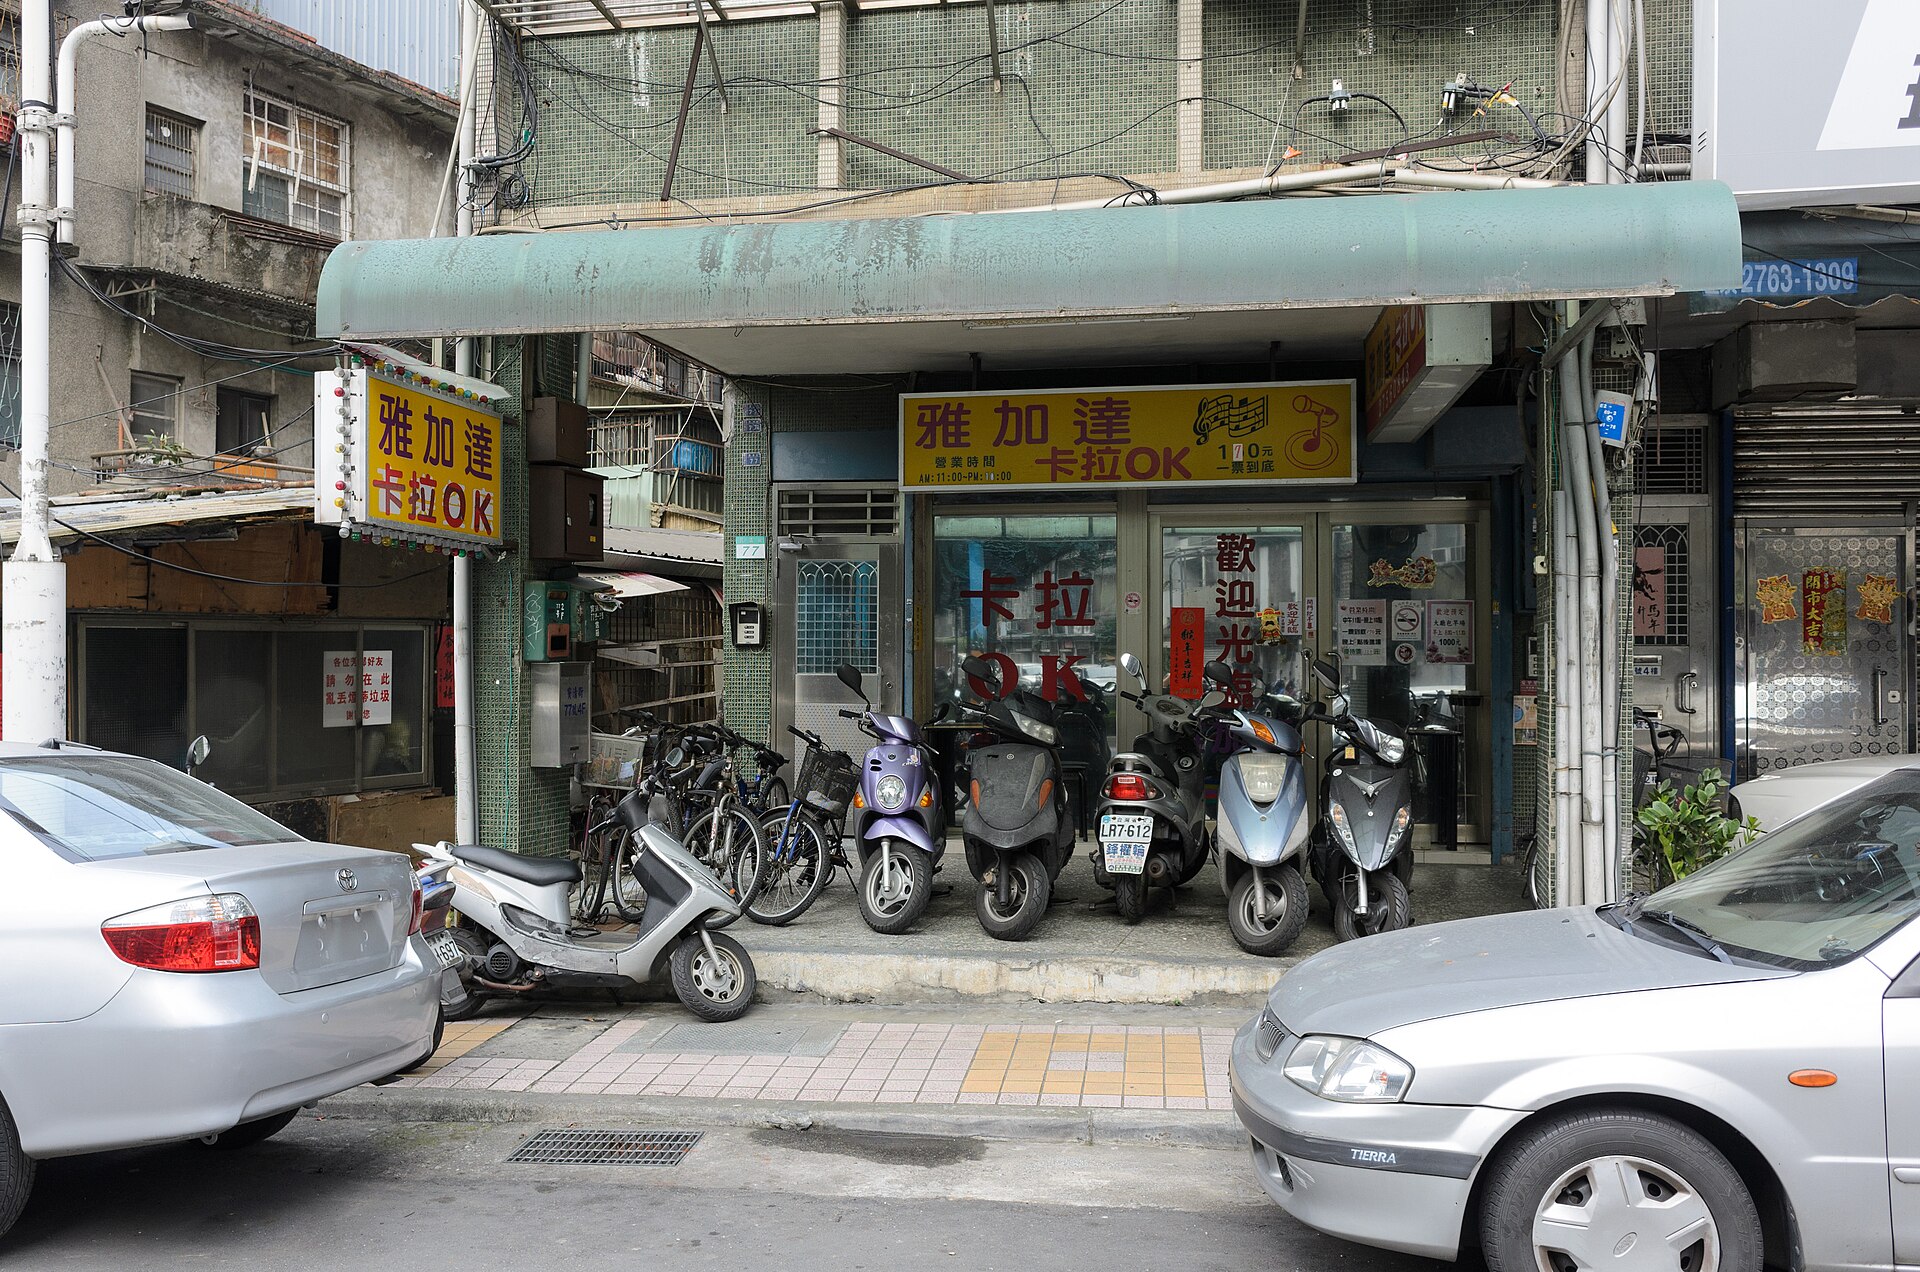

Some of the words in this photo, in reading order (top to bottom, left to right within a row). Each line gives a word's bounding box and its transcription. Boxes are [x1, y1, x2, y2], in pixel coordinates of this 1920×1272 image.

[1742, 261, 1854, 294] 2763-1309
[378, 393, 493, 481] 雅加達
[914, 396, 1132, 450] 雅加達
[935, 455, 996, 469] 營業時間
[1034, 445, 1193, 482] 卡拉OK
[1216, 460, 1275, 474] 一票到底
[372, 462, 493, 536] 卡拉OK
[742, 545, 760, 557] 77
[960, 568, 1096, 630] 卡拉
[1804, 575, 1822, 637] 開市大吉
[1647, 604, 1661, 634] 馬年
[1180, 628, 1195, 684] 猴年吉祥
[325, 673, 391, 688] 請勿在此
[1351, 1148, 1397, 1165] TIERRA
